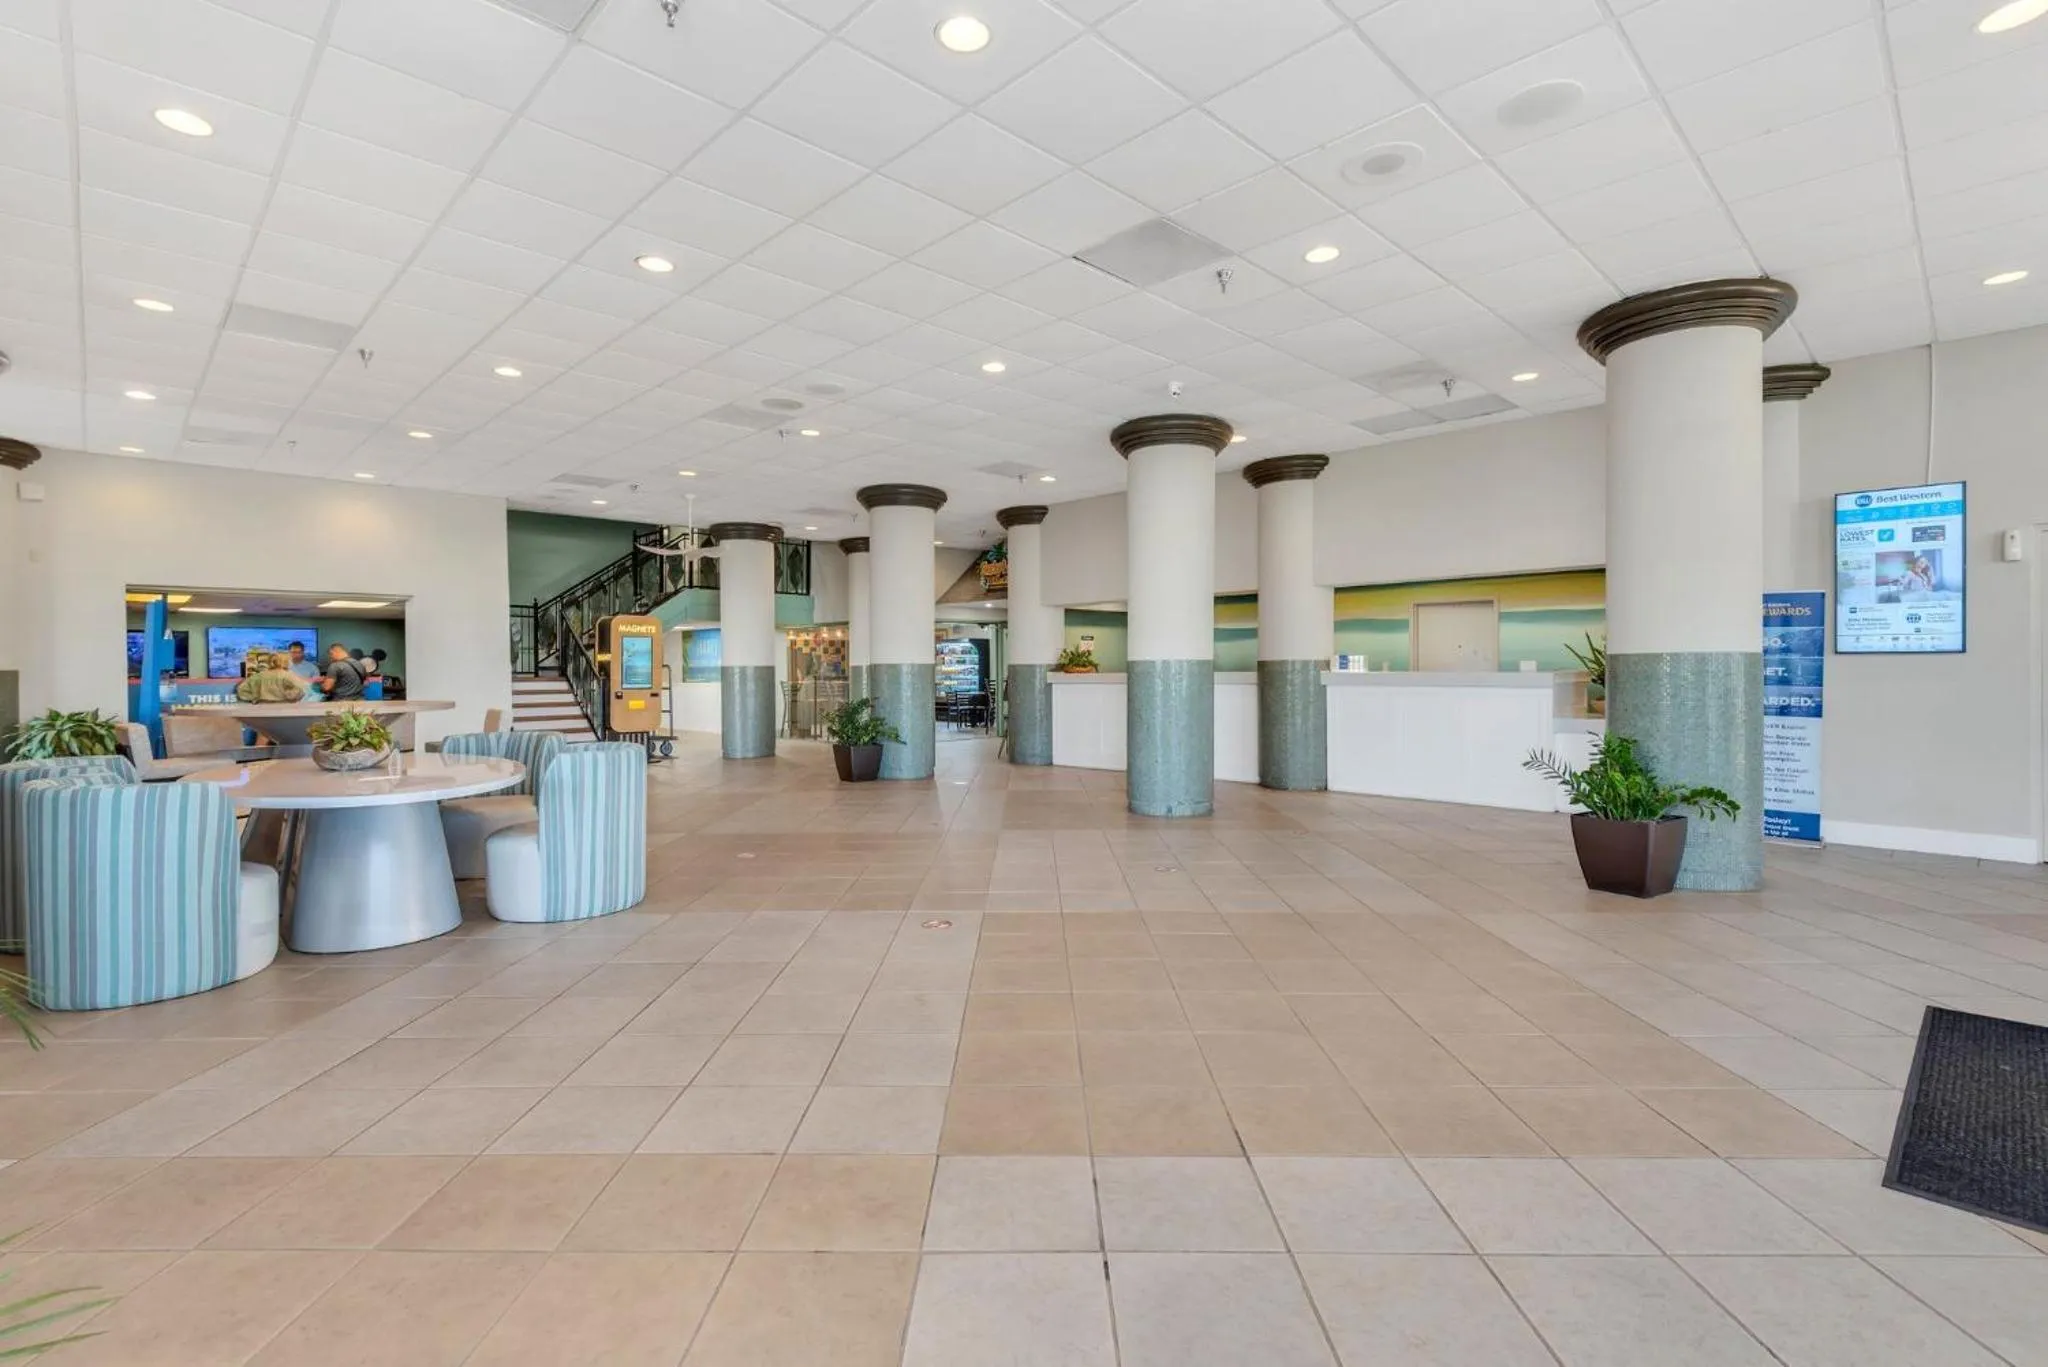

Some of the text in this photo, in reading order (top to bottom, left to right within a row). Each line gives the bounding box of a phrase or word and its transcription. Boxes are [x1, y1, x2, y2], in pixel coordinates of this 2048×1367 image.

[1876, 489, 1943, 504] Best Western
[618, 624, 656, 633] MAGNETS
[189, 694, 237, 703] THIS IS
